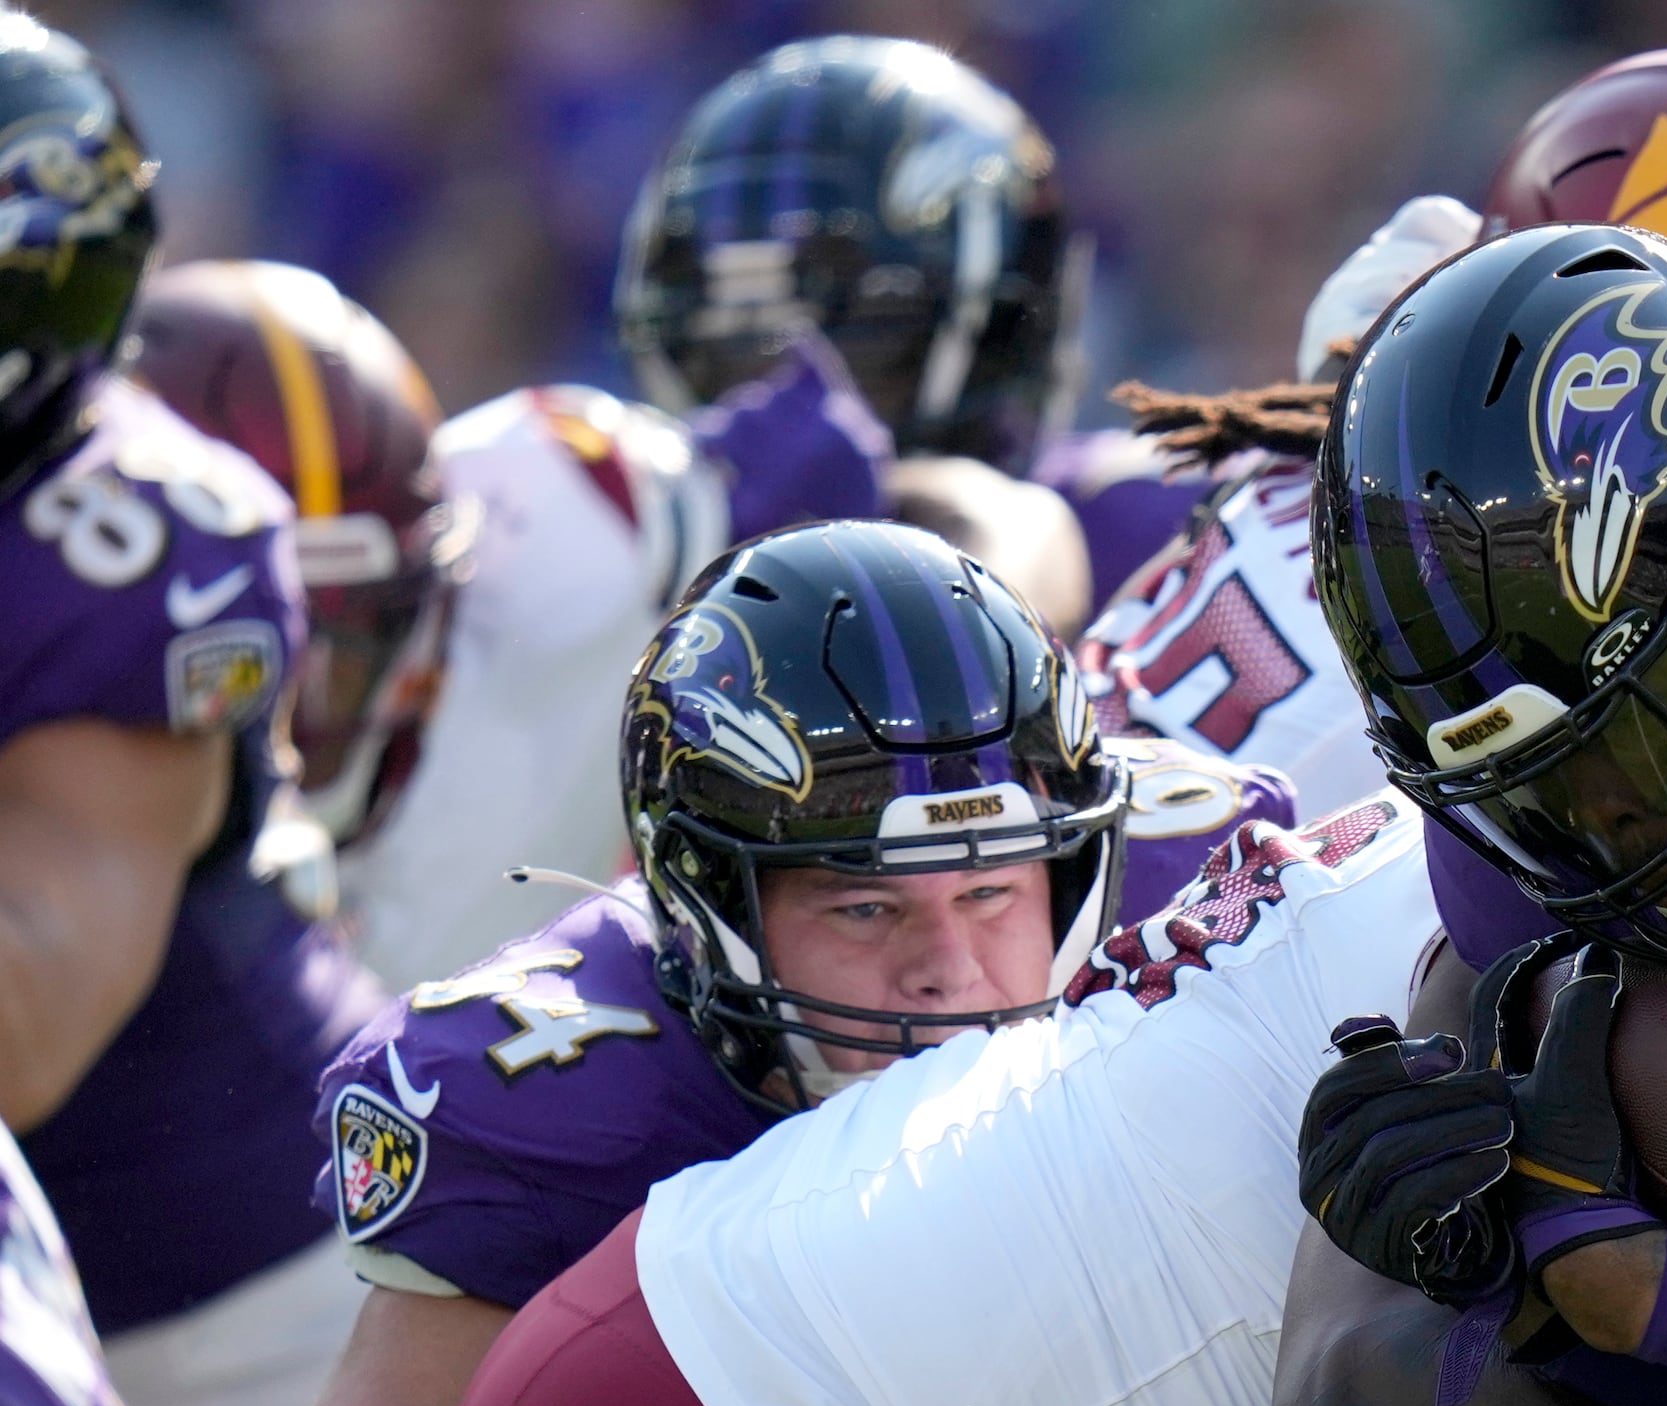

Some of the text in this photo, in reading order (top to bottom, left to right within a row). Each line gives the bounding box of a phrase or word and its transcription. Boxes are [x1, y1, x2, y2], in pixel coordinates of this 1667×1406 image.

[1592, 620, 1651, 687] OAKLEY
[1441, 706, 1514, 752] RAVENS
[924, 795, 1004, 825] RAVENS
[344, 1096, 412, 1146] RAVENS
